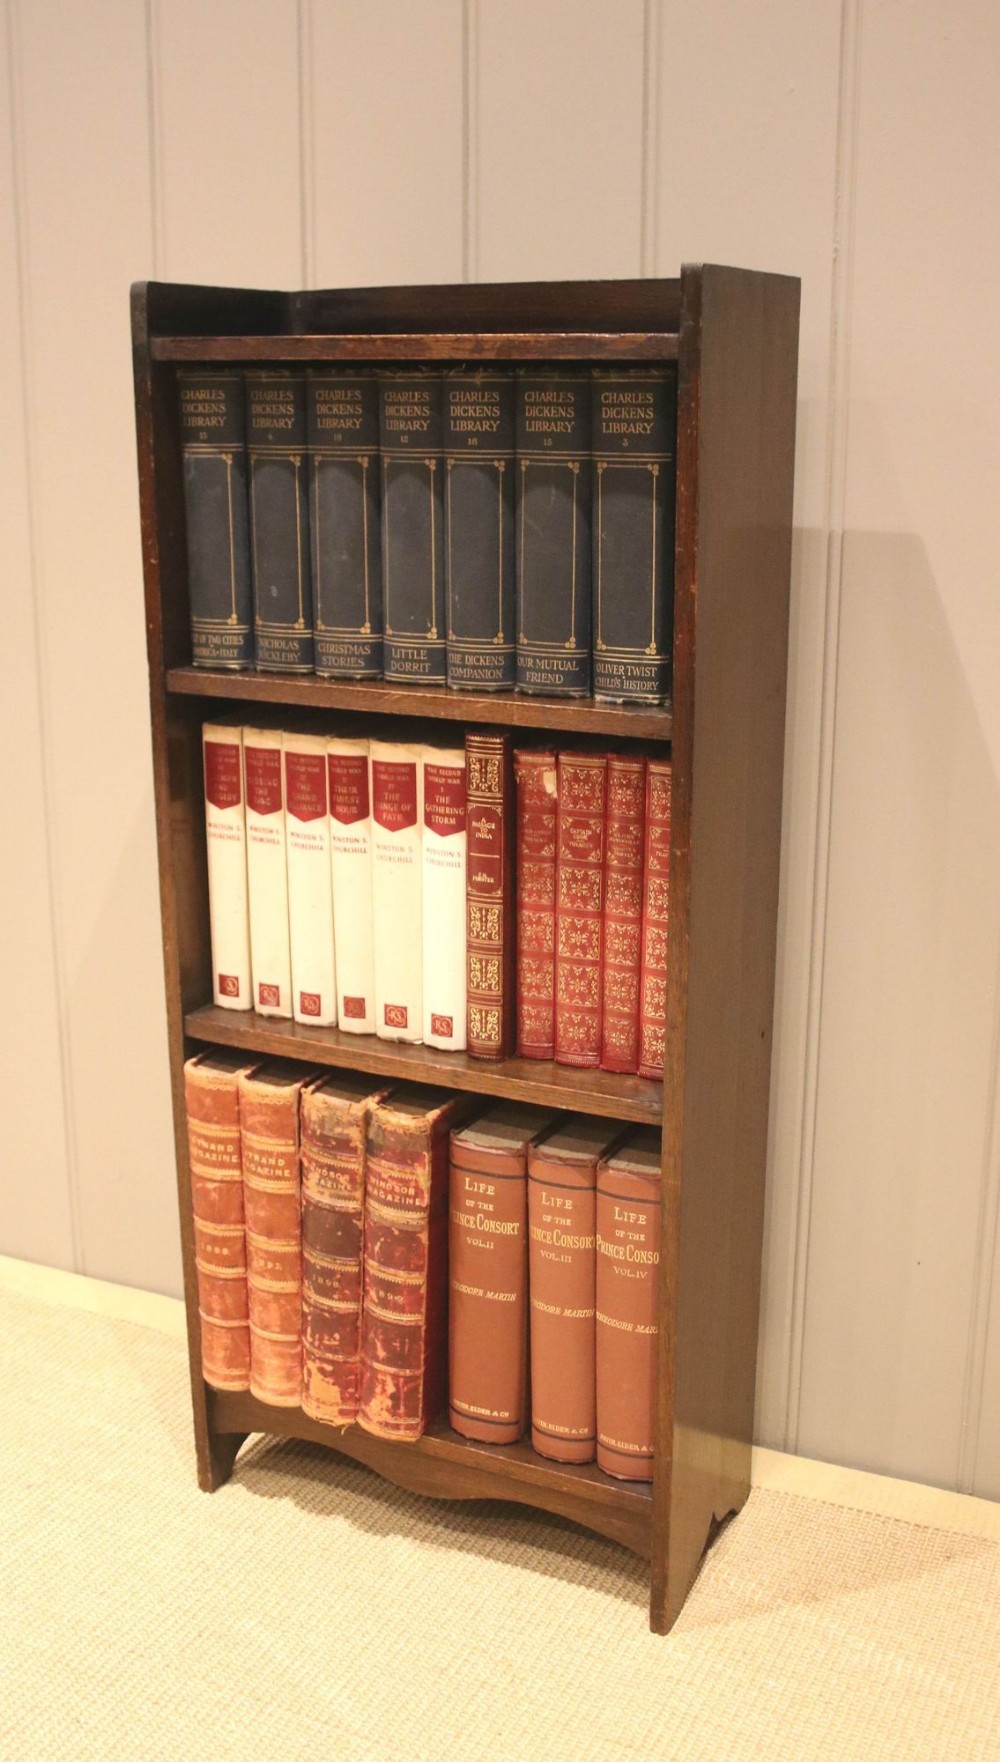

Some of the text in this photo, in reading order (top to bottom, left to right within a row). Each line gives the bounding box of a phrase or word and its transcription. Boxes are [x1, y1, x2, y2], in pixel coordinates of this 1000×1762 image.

[182, 389, 225, 400] CHARLES
[252, 390, 294, 400] CHARLES
[316, 390, 361, 400] CHARLES
[384, 391, 429, 402] CHARLES
[450, 392, 500, 402] CHARLES
[524, 392, 575, 402] CHARLES
[601, 392, 654, 404] CHARLES
[182, 403, 226, 414] DICKENS
[252, 404, 294, 415] DICKENS
[316, 404, 362, 415] DICKENS
[385, 405, 430, 417] DICKENS
[450, 406, 500, 417] DICKENS
[525, 406, 575, 417] DICKENS
[602, 407, 654, 419] DICKENS
[184, 416, 226, 427] LIBRARY
[252, 417, 295, 429] LIBRARY
[317, 417, 363, 429] LIBRARY
[386, 419, 430, 431] LIBRARY
[450, 420, 500, 432] LIBRARY
[526, 420, 575, 433] LIBRARY
[602, 422, 655, 434] LIBRARY
[258, 638, 299, 650] NICHOLAS
[318, 642, 371, 656] CHRISTMAS
[259, 650, 300, 662] NICKLEBY
[392, 648, 428, 661] LITTLE
[450, 653, 505, 666] THE DICKENS
[322, 656, 365, 668] STORIES
[391, 660, 431, 673] DORRIT
[517, 657, 579, 671] OUR MUTUAL
[450, 666, 503, 679] COMPANION
[596, 663, 658, 678] OLIVER TWIST
[526, 671, 564, 684] FRIEND
[623, 678, 658, 691] HISTORY
[384, 792, 400, 801] THE
[435, 795, 450, 804] THE
[425, 803, 464, 815] GATHERING
[431, 815, 456, 825] STORM
[465, 1177, 495, 1195] LIFE
[477, 1201, 494, 1211] THE
[541, 1192, 573, 1210] LIFE
[554, 1216, 572, 1226] THE
[614, 1207, 647, 1225] LIFE
[476, 1213, 519, 1235] CONSORT
[615, 1229, 646, 1241] OF THE
[596, 1234, 659, 1265] PRINCE CONSO
[485, 1291, 516, 1301] MARTIN
[596, 1311, 633, 1331] THEODORE
